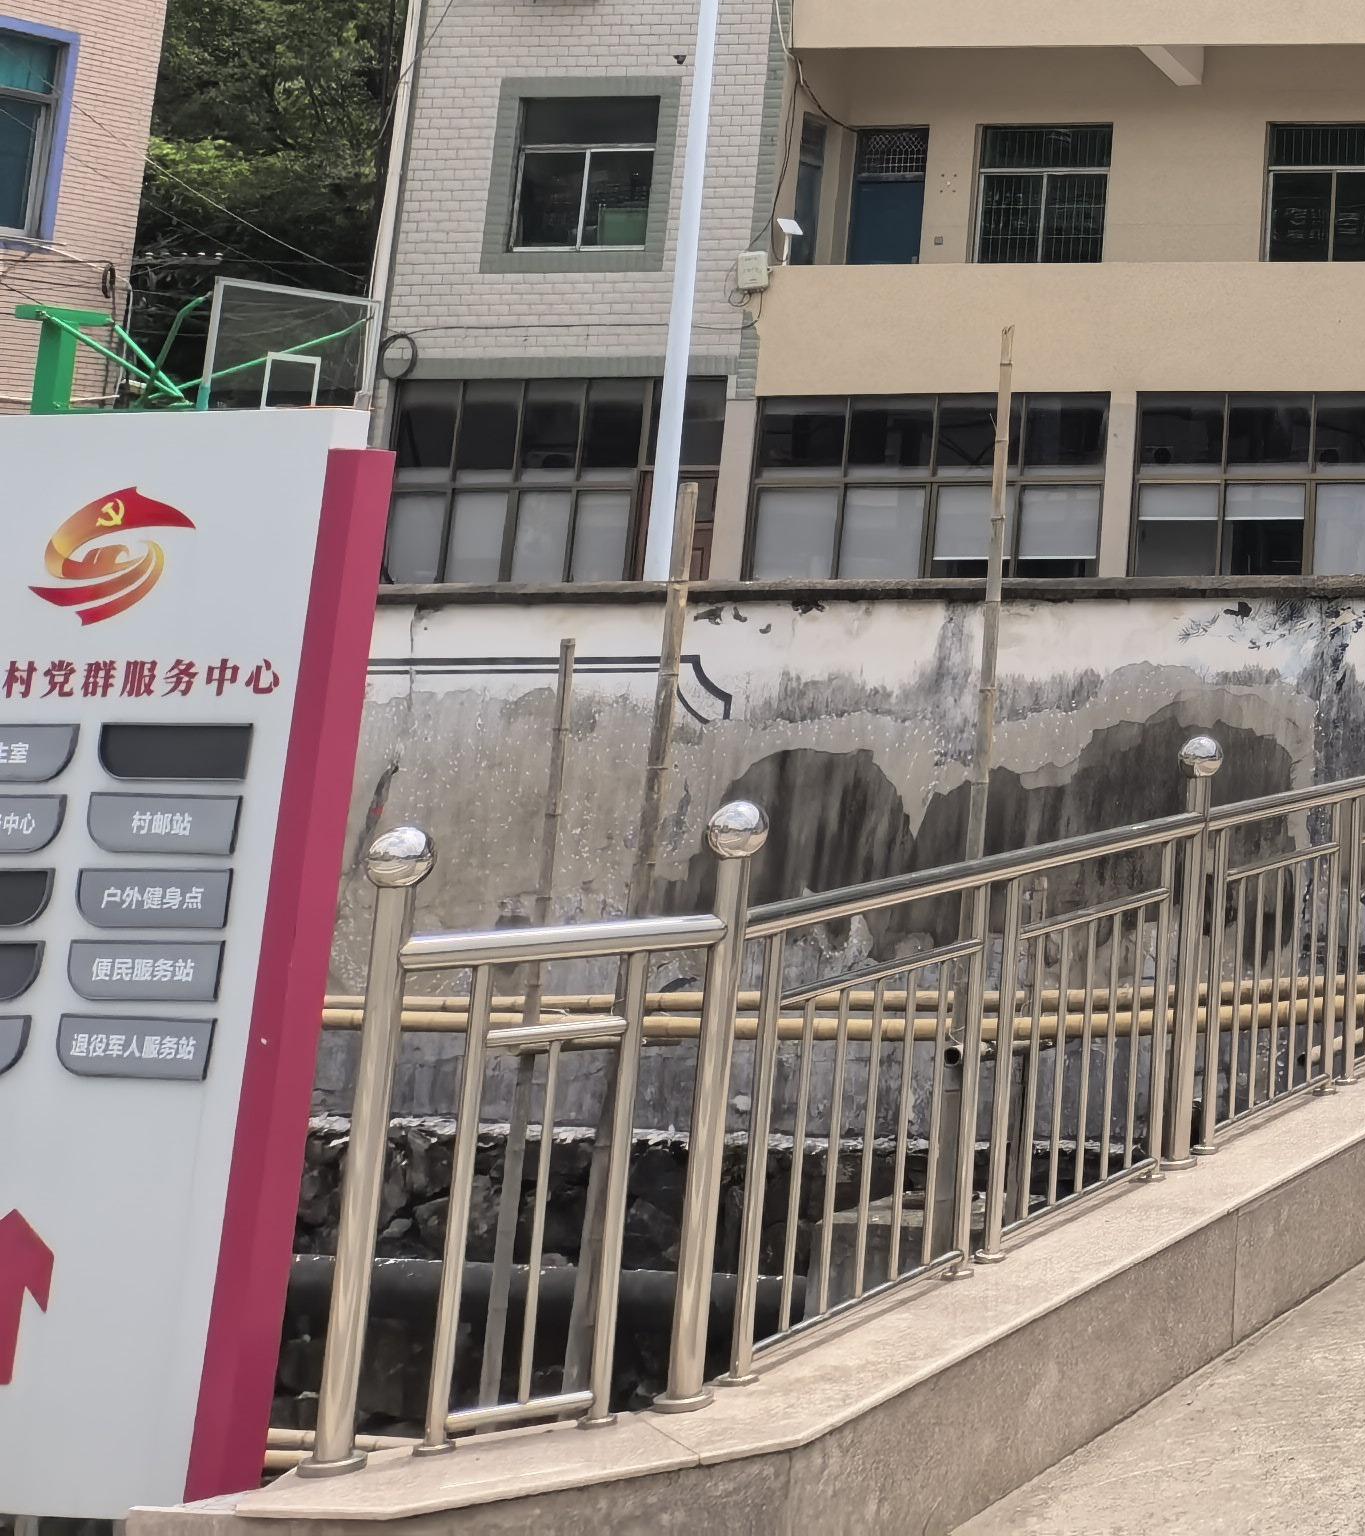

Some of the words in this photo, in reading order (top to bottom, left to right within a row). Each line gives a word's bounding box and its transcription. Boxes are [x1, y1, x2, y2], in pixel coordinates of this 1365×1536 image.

[2, 659, 280, 698] 村党群服务中心
[0, 813, 36, 836] 中心
[132, 811, 193, 836] 村邮站
[101, 886, 205, 910] 户外健身点
[92, 957, 195, 982] 便民服务站
[70, 1033, 197, 1060] 退役军人服务站
